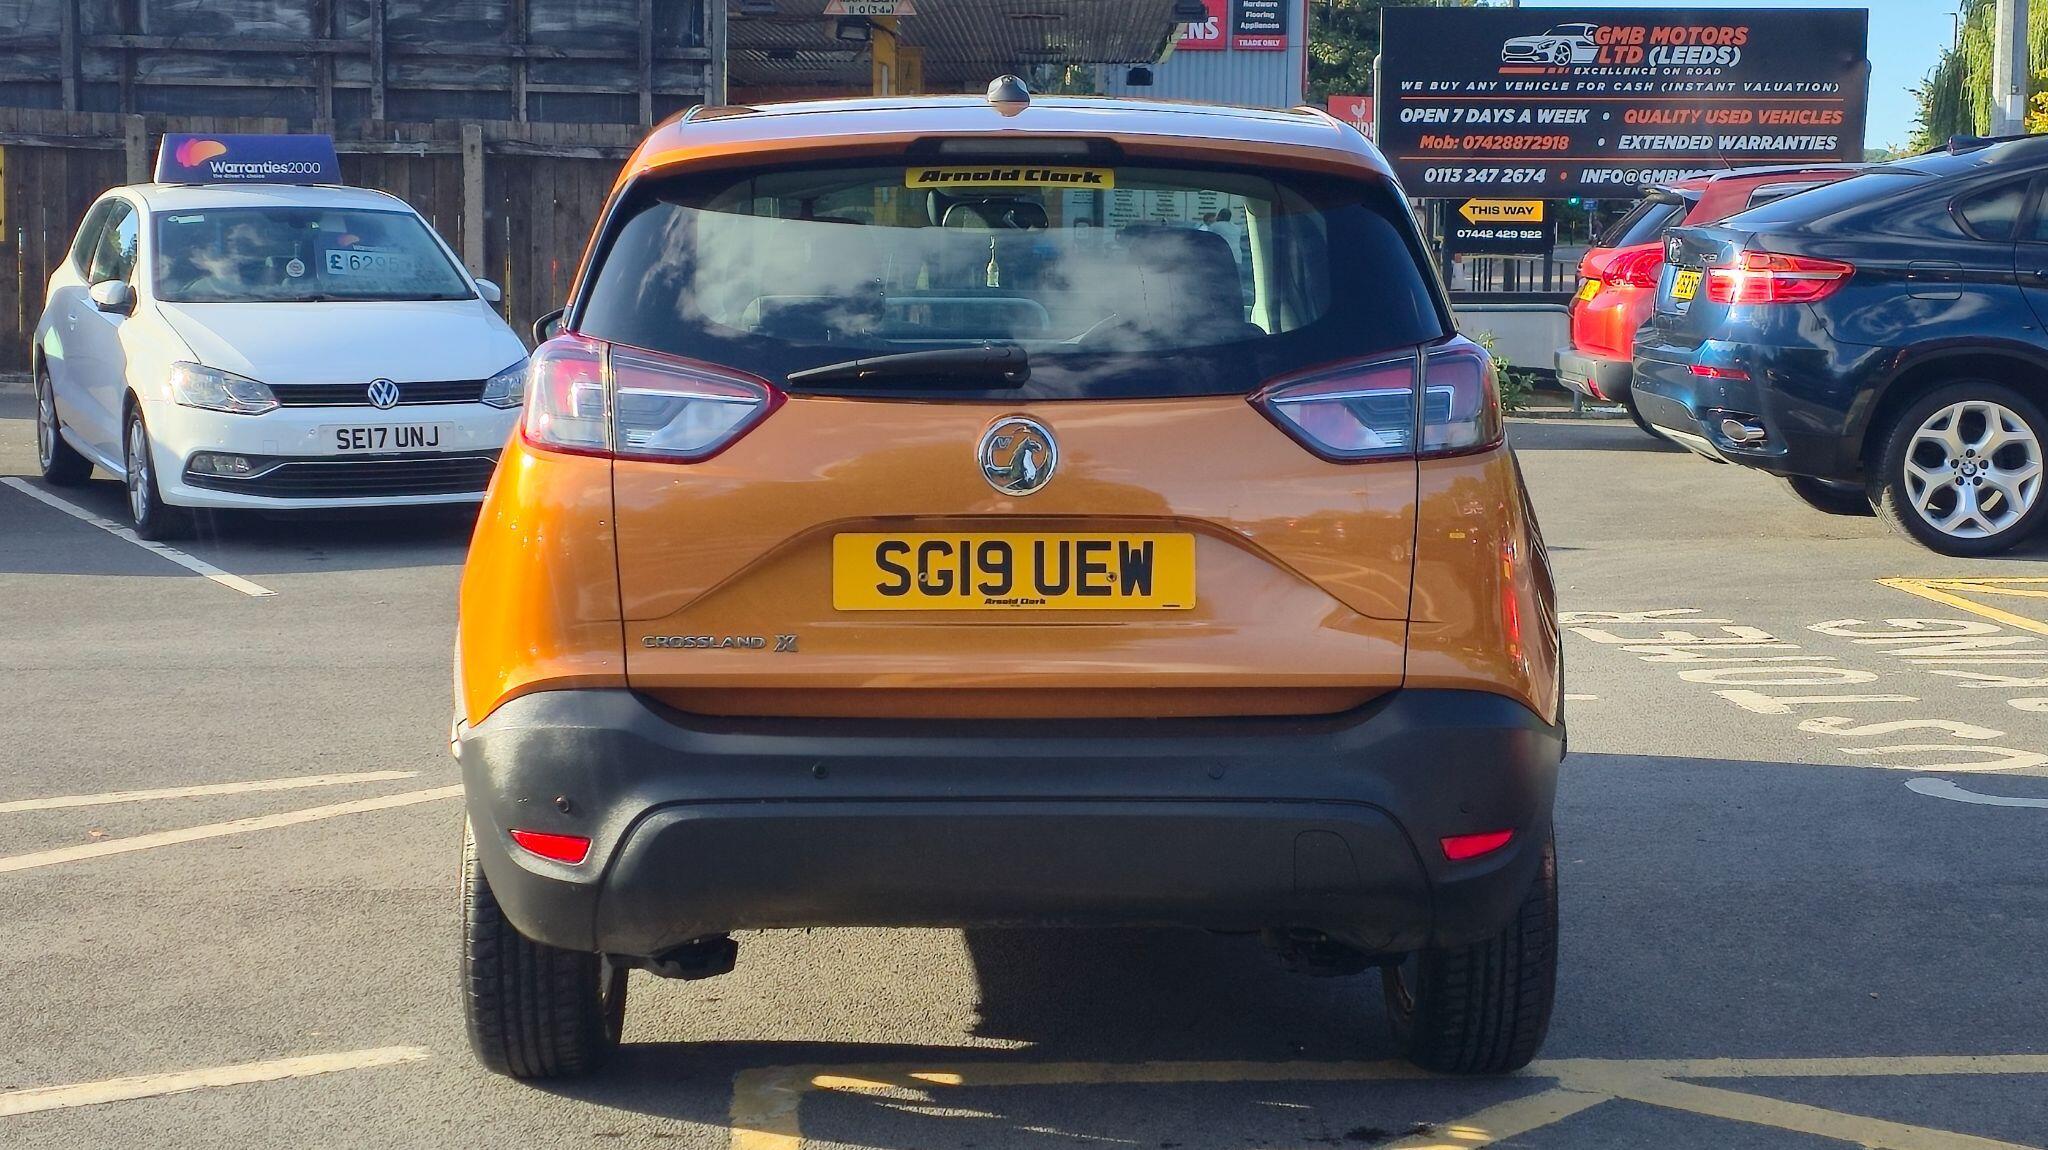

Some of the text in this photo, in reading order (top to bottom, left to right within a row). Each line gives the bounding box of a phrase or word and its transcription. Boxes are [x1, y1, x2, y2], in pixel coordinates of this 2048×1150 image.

[1243, 0, 1278, 8] Hardware
[1245, 11, 1275, 20] Flooring
[1180, 16, 1219, 40] NS
[1240, 21, 1280, 30] Appliances
[1238, 39, 1280, 47] TRADE ONLY
[1594, 26, 1749, 46] GMB MOTORS
[1598, 45, 1742, 68] LTD (LEEDS)
[1574, 67, 1721, 76] EXCELLENCE ON ROAD
[1401, 81, 1840, 92] WE BUY ANY VEHICLE FOR CASH (INSTANT VALUATION)
[1400, 108, 1590, 124] OPEN 7 DAYS A WEEK
[1624, 109, 1844, 124] QUALITY USED VEHICLES
[1419, 135, 1570, 150] Mob: 07428872918
[1618, 135, 1837, 150] EXTENDED WARRANTIES
[210, 161, 321, 174] Warranties2000
[918, 169, 1103, 184] Arnold Clark
[1424, 168, 1547, 183] 0113 247 2674
[1469, 206, 1535, 215] THIS WAY
[1457, 229, 1542, 239] 07442 429 922
[336, 426, 439, 450] SE17 UNJ
[875, 540, 1154, 597] SG19 UEW
[641, 634, 799, 652] CROSSLAND X
